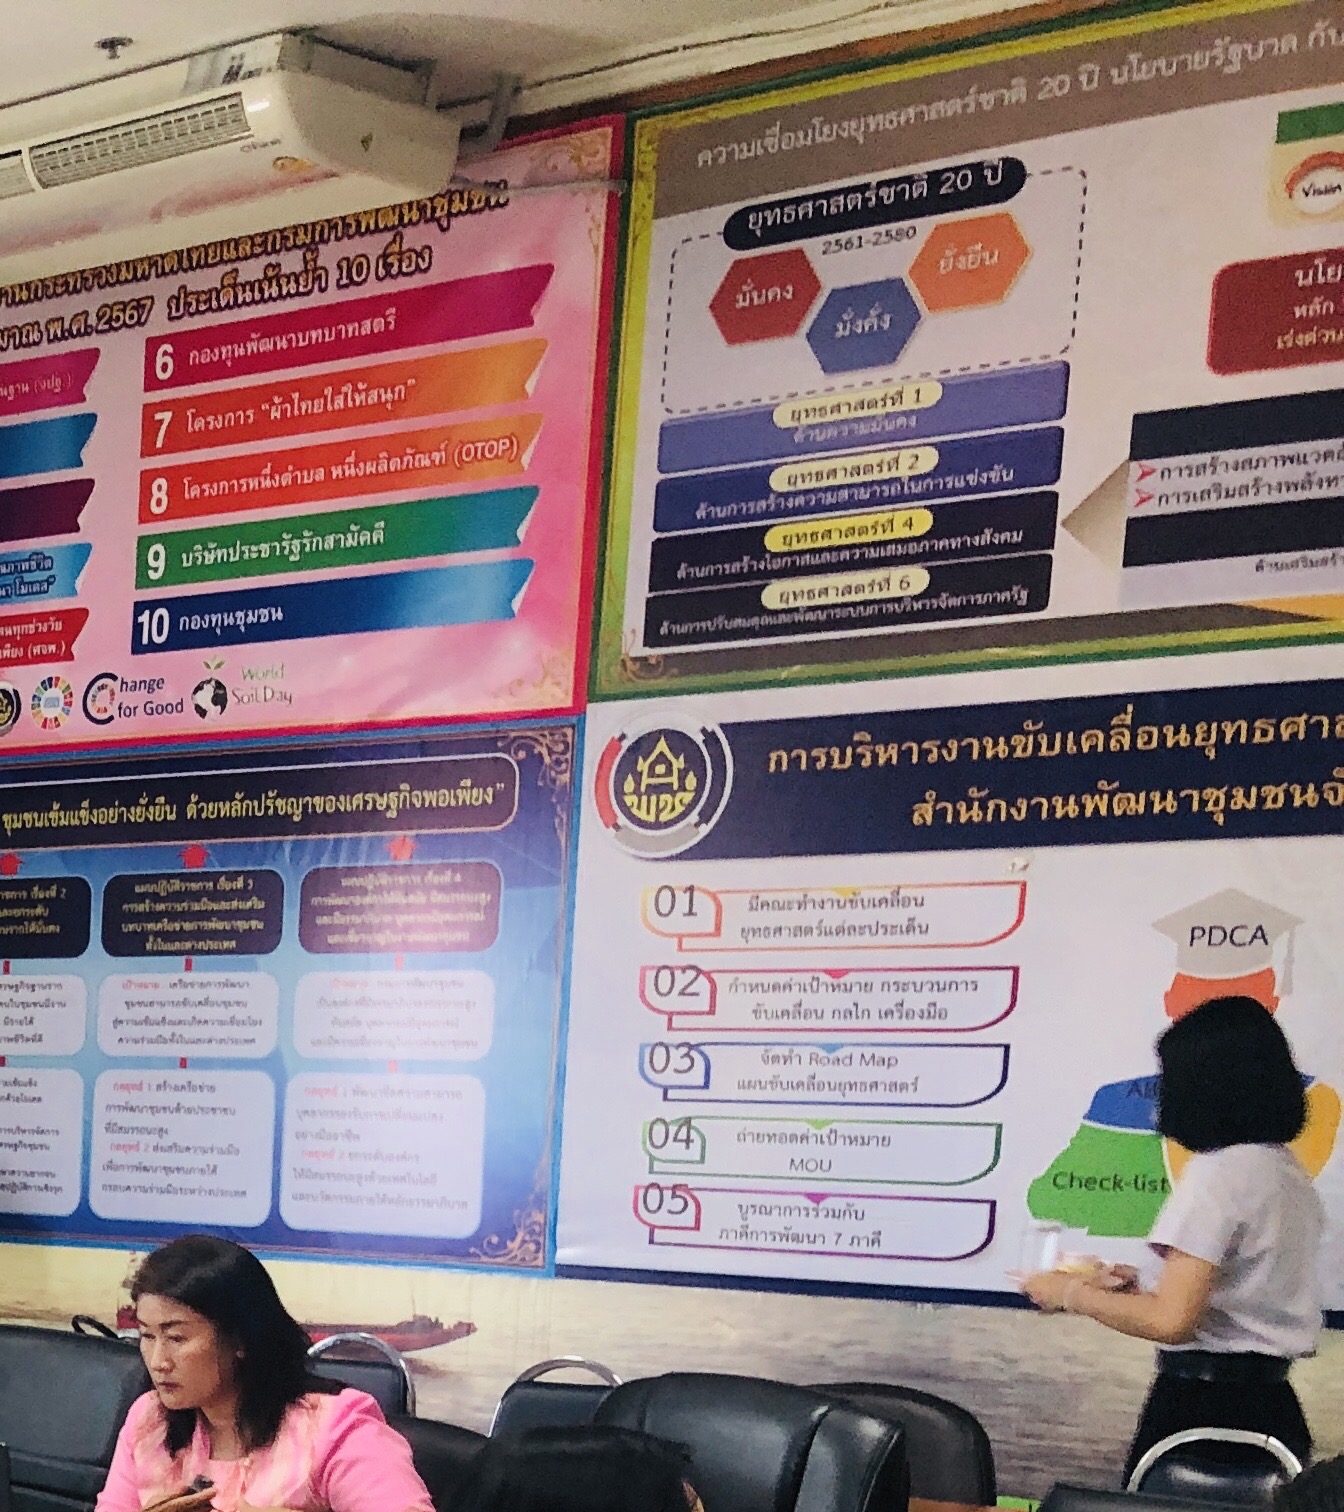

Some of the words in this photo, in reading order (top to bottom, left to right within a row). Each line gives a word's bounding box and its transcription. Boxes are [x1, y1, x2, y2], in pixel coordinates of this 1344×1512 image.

[697, 78, 1028, 168] ความเชื่อมโยงยุทธศาสตร์ชาติ
[1036, 73, 1071, 101] 20
[748, 172, 928, 237] ยุทธศาสตร์ชาติ
[938, 170, 973, 196] 20
[983, 155, 1006, 187] ปี
[822, 225, 917, 256] 2561-2580
[167, 249, 330, 322] ประเด็นเน้นย้ำ
[336, 252, 371, 287] 10
[375, 230, 435, 281] เรื่อง
[938, 244, 1001, 276] ยั่งยืน
[735, 279, 794, 309] มั่นคง
[834, 301, 892, 339] มั่งคั่ง
[155, 343, 174, 380] 6
[188, 308, 397, 366] กองทุนพัฒนาบทบาทสตรี
[789, 389, 904, 424] ยุทธศาสตร์ที่
[153, 411, 172, 447] 7
[186, 406, 254, 434] โครงการ
[150, 478, 168, 514] 8
[183, 462, 325, 500] โครงการหนึ่งตำบล
[330, 440, 447, 481] หนึ่งผลิตภัณฑ์
[453, 434, 519, 469] (OTOP)
[786, 453, 900, 487] ยุทธศาสตร์ที่
[906, 453, 920, 470] 2
[147, 543, 165, 579] 9
[181, 521, 385, 568] บริษัทประชารัฐรักสามัคคี
[781, 516, 895, 550] ยุทธศาสตร์ที่
[778, 578, 892, 609] ยุทธศาสตร์ที่
[899, 576, 912, 592] 6
[137, 607, 170, 645] 10
[179, 604, 283, 636] กองทุนชุมชน
[242, 663, 285, 681] World
[118, 702, 139, 718] for
[143, 698, 184, 718] Good
[232, 687, 260, 706] Soil
[262, 688, 293, 709] Day
[1, 792, 177, 837] ชุมชนเข้มแข็งอย่างยั่งยืน
[186, 779, 505, 823] ด้วยหลักปรัชญาของเศรษฐกิจพอเพียง”
[653, 884, 698, 919] 01
[748, 886, 925, 912] มีคณะทำงานขับเคลื่อน
[740, 915, 930, 943] ยุทธศาสตร์แต่ละประเด็น
[1189, 925, 1269, 948] PDCA
[653, 964, 701, 997] 02
[728, 975, 874, 996] กำหนดค่าเป้าหมาย
[880, 977, 979, 994] กระบวนการ
[752, 1001, 825, 1022] ขับเคลื่อน
[831, 1002, 871, 1022] กลไก
[878, 1001, 949, 1022] เครื่องมือ
[648, 1041, 696, 1075] 03
[760, 1049, 803, 1067] จัดทำ
[809, 1051, 853, 1067] Road
[859, 1053, 899, 1070] Map
[736, 1073, 920, 1097] แผนขับเคลื่อนยุทธศาสตร์
[648, 1116, 694, 1151] 04
[736, 1126, 891, 1149] ถ่ายทอดค่าเป้าหมาย
[789, 1158, 832, 1173] MOU
[642, 1182, 690, 1215] 05
[737, 1201, 866, 1224] บูรณาการร่วมกับ
[718, 1225, 826, 1246] ภาคีการพัฒนา
[834, 1232, 842, 1246] 7
[848, 1229, 882, 1249] ภาคี
